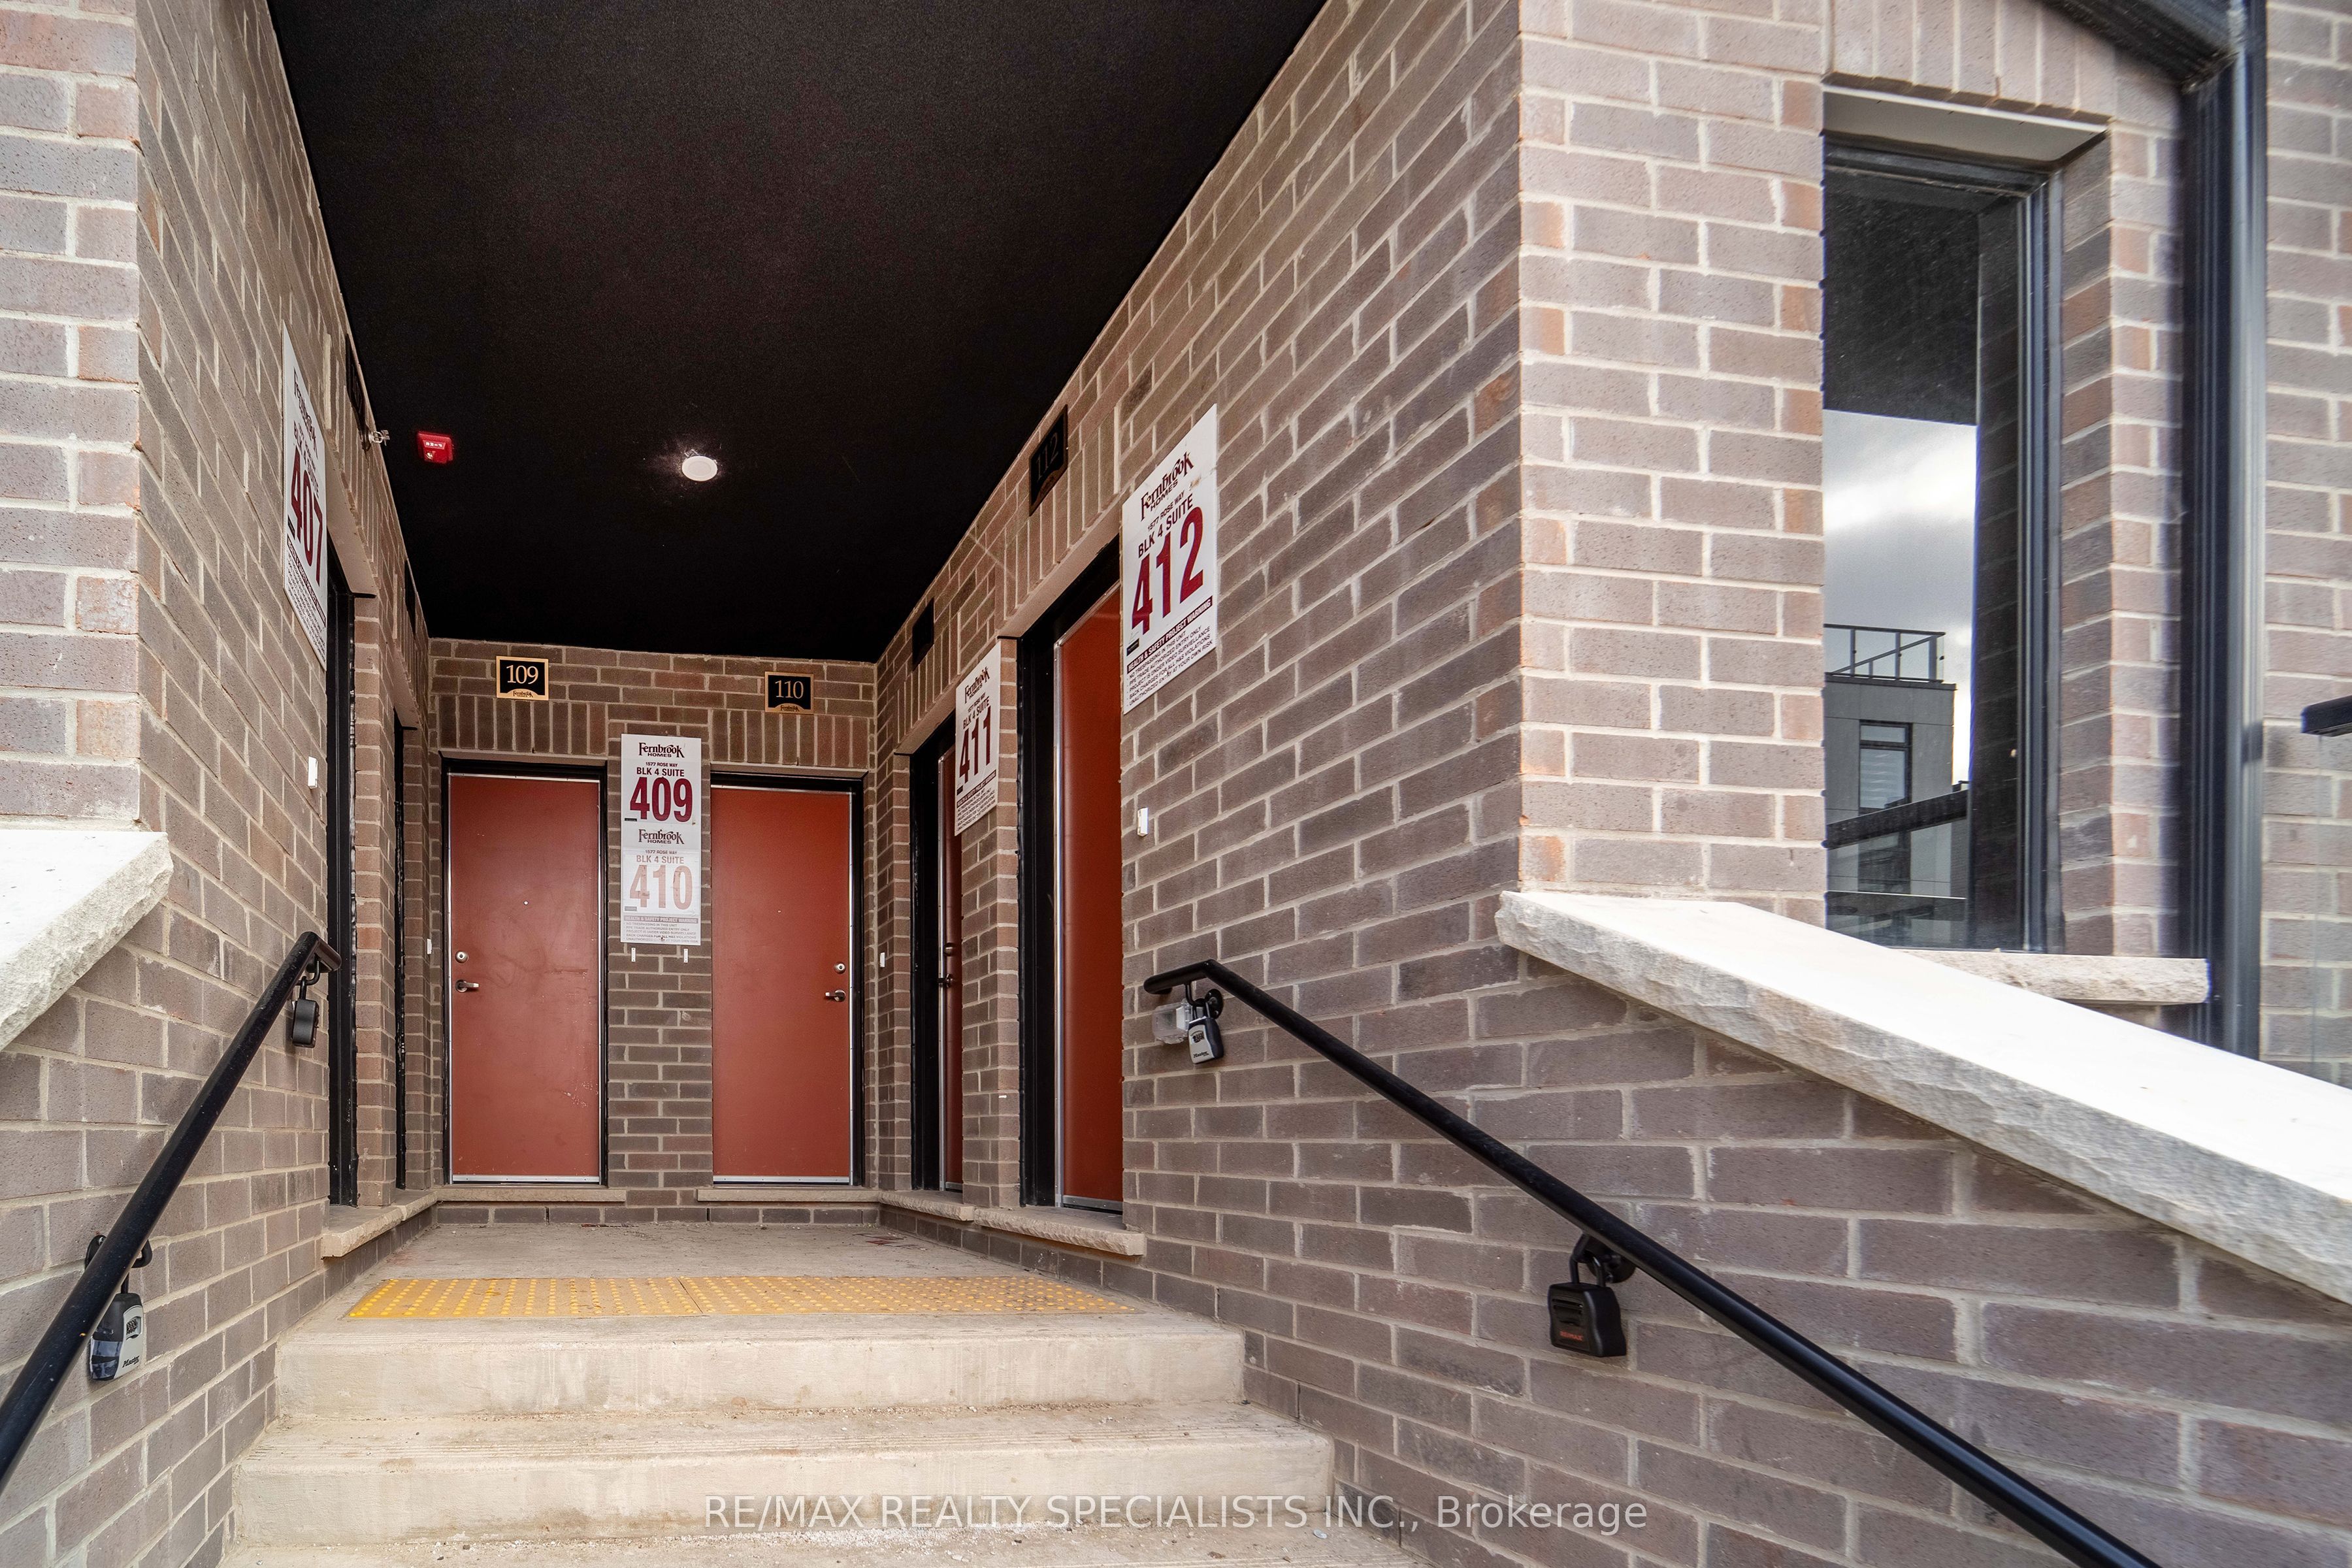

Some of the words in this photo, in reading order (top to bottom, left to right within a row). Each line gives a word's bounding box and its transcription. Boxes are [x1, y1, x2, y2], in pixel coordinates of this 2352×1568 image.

[1036, 433, 1058, 481] 112
[1141, 451, 1194, 521] Fernbrook
[1151, 479, 1177, 511] HOMES
[291, 447, 323, 587] 407
[1138, 531, 1154, 558] BLK
[1157, 523, 1162, 539] 4
[1166, 494, 1192, 531] SUITE
[1147, 516, 1159, 531] 1577
[1160, 502, 1173, 519] ROSE
[1175, 491, 1184, 505] WAY
[1132, 507, 1203, 634] 412
[1128, 653, 1143, 672] HEALTH
[1144, 650, 1147, 659] &
[1149, 636, 1164, 655] SAFETY
[1166, 619, 1186, 642] PROJECT
[1187, 599, 1210, 624] WARNING
[506, 665, 538, 684] 109
[775, 680, 804, 699] 110
[963, 713, 972, 729] BLK
[977, 696, 989, 716] SUITE
[639, 742, 685, 758] Fernbrook
[959, 706, 991, 783] 411
[662, 768, 684, 777] SUITE
[630, 777, 693, 822] 409
[638, 829, 685, 844] Fernbrook
[630, 865, 693, 909] 410
